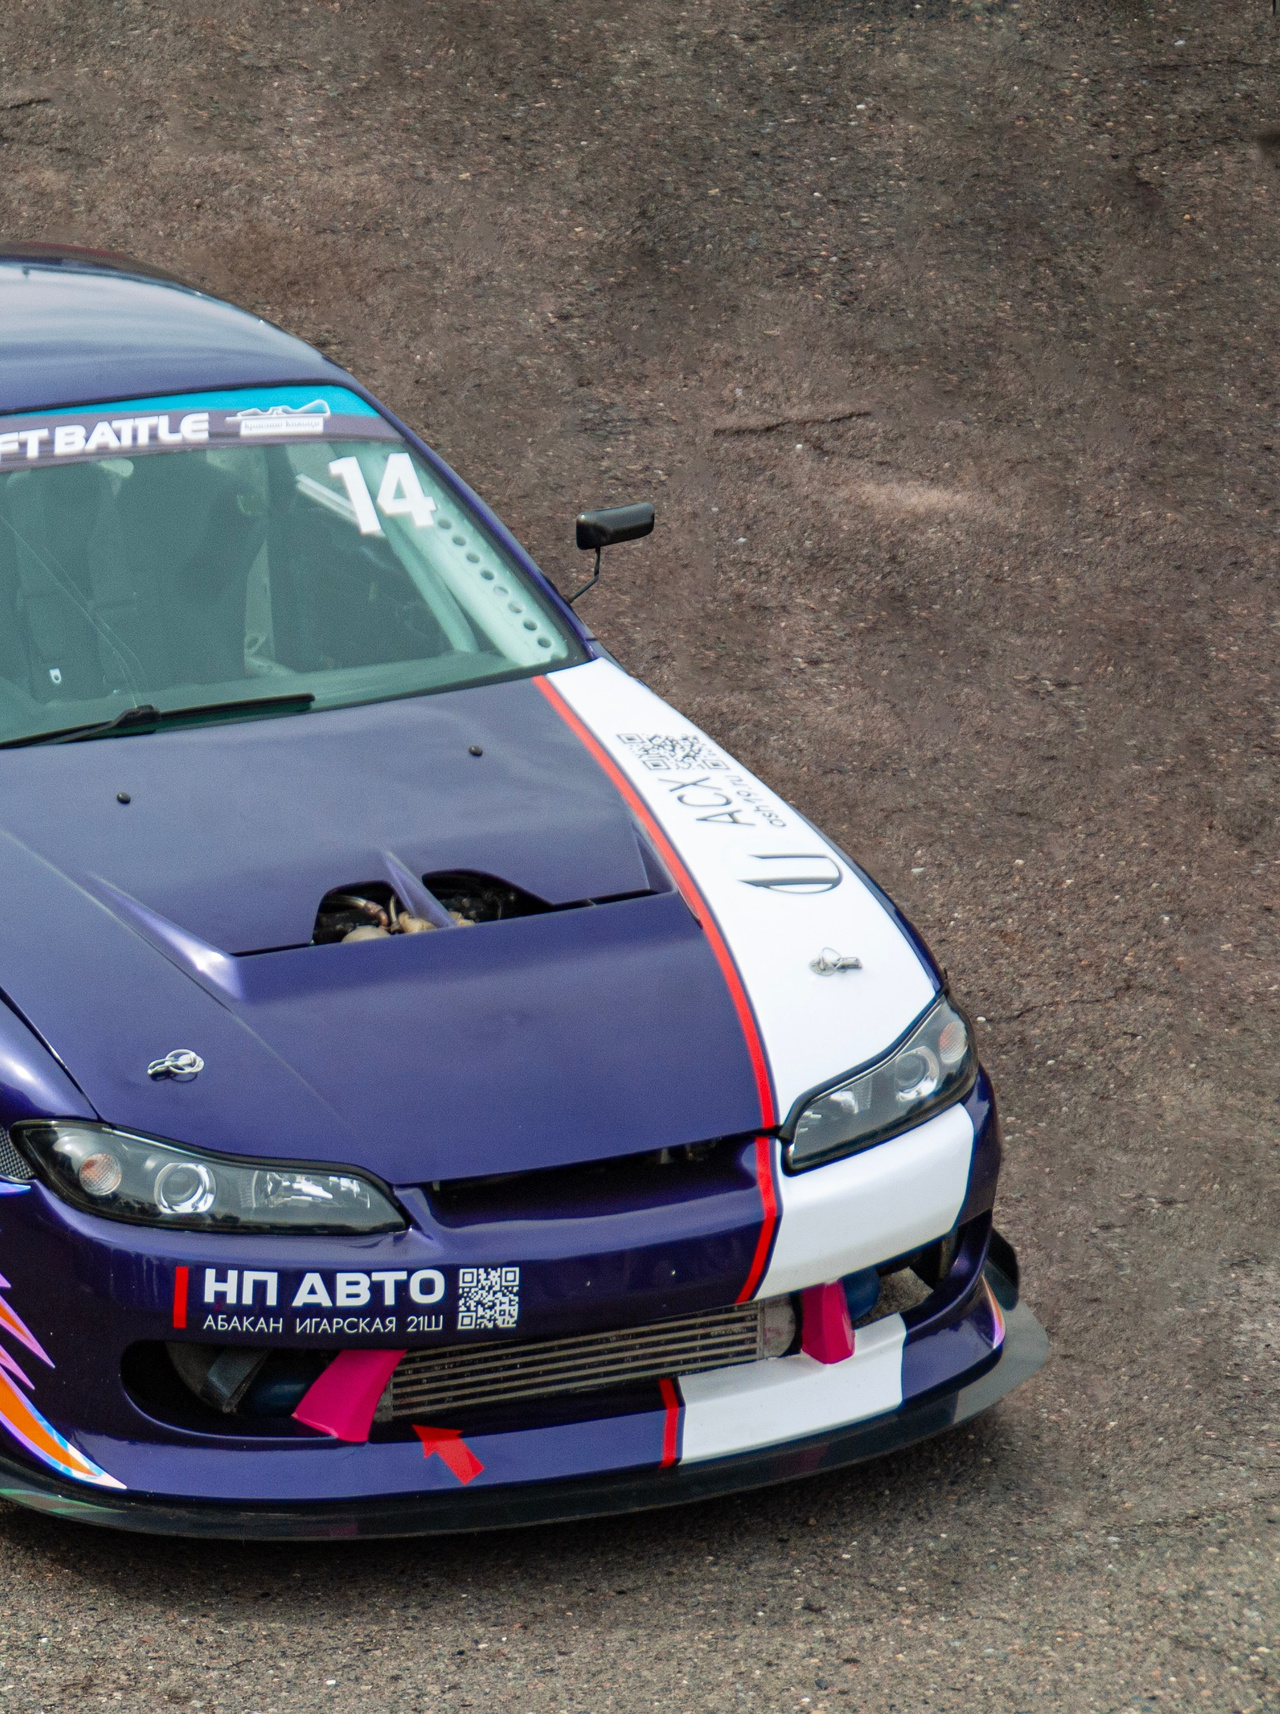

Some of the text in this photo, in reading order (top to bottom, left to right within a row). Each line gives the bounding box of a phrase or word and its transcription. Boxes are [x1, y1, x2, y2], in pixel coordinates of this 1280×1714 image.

[53, 412, 210, 455] BATTLE
[329, 452, 436, 534] 14
[204, 1267, 445, 1308] НП АВТО
[202, 1314, 444, 1334] АБАКАН ИГАРСКАЯ 21Ш
